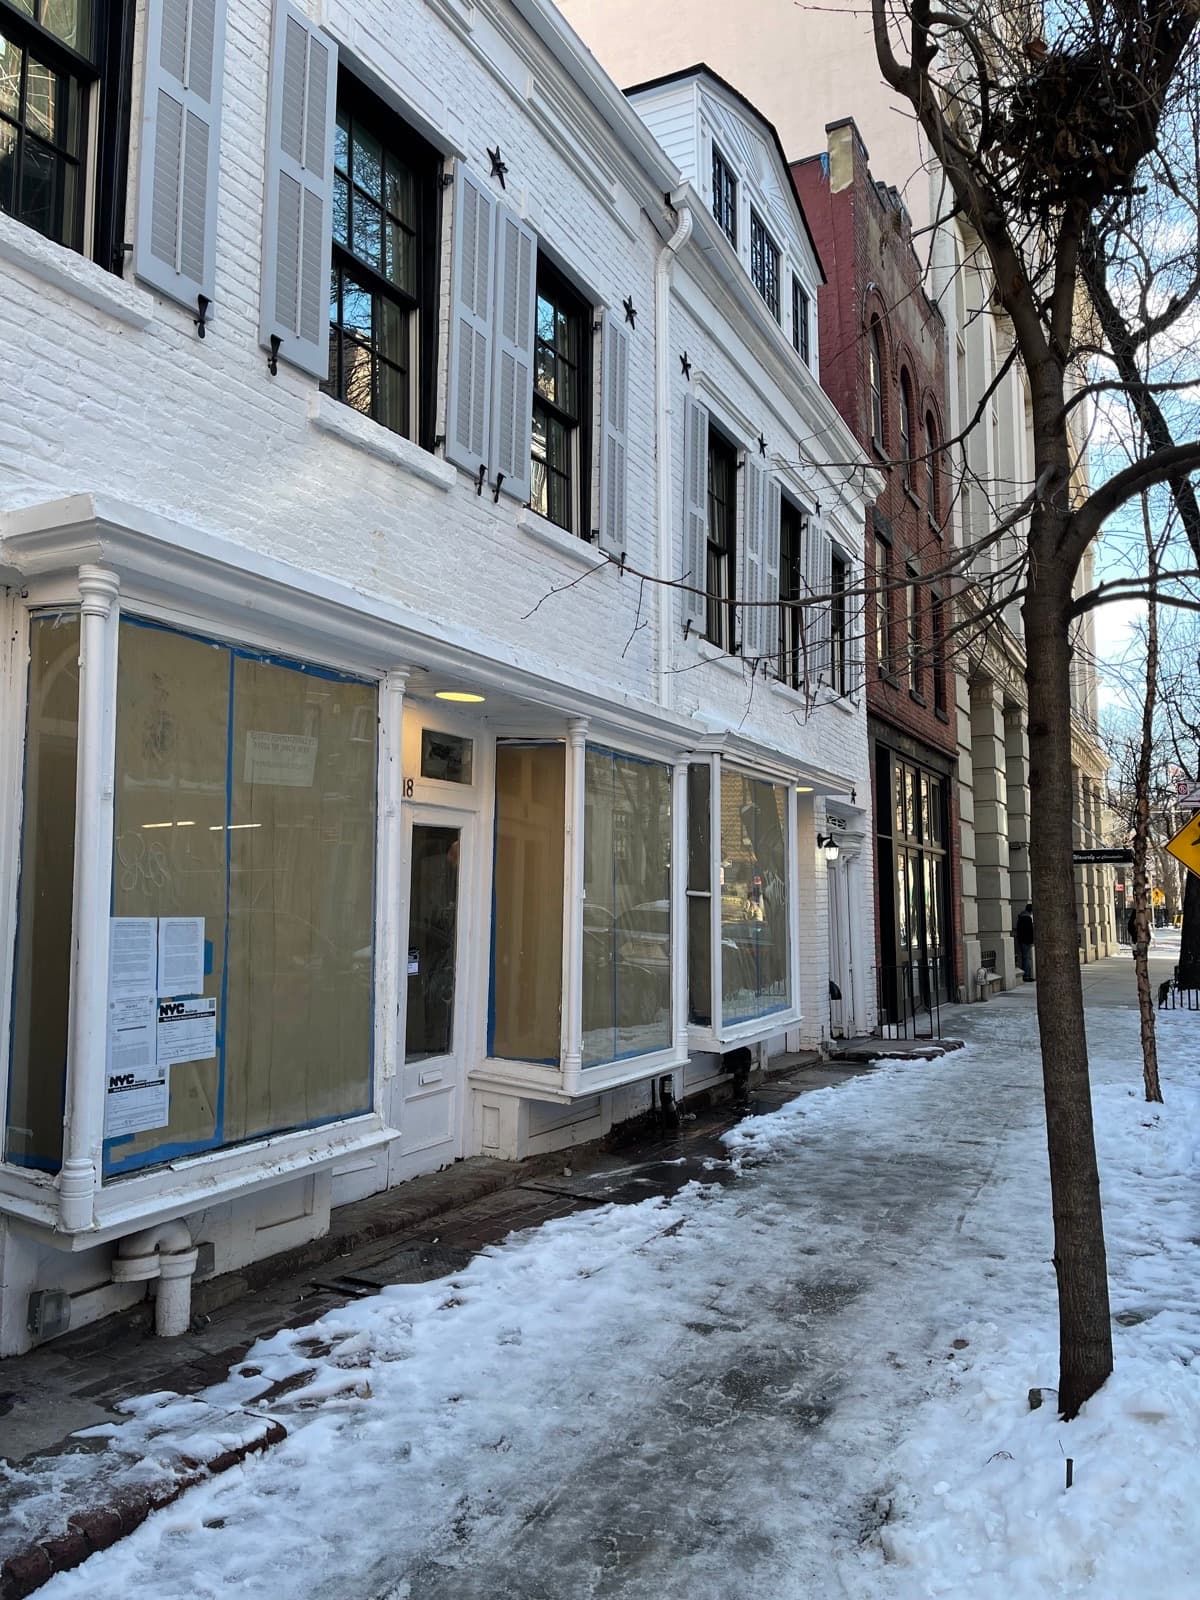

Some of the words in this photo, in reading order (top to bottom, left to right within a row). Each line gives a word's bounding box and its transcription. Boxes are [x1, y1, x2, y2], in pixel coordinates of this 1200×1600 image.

[403, 779, 414, 798] 18
[160, 1003, 185, 1017] NYC
[109, 1073, 135, 1088] NYC
